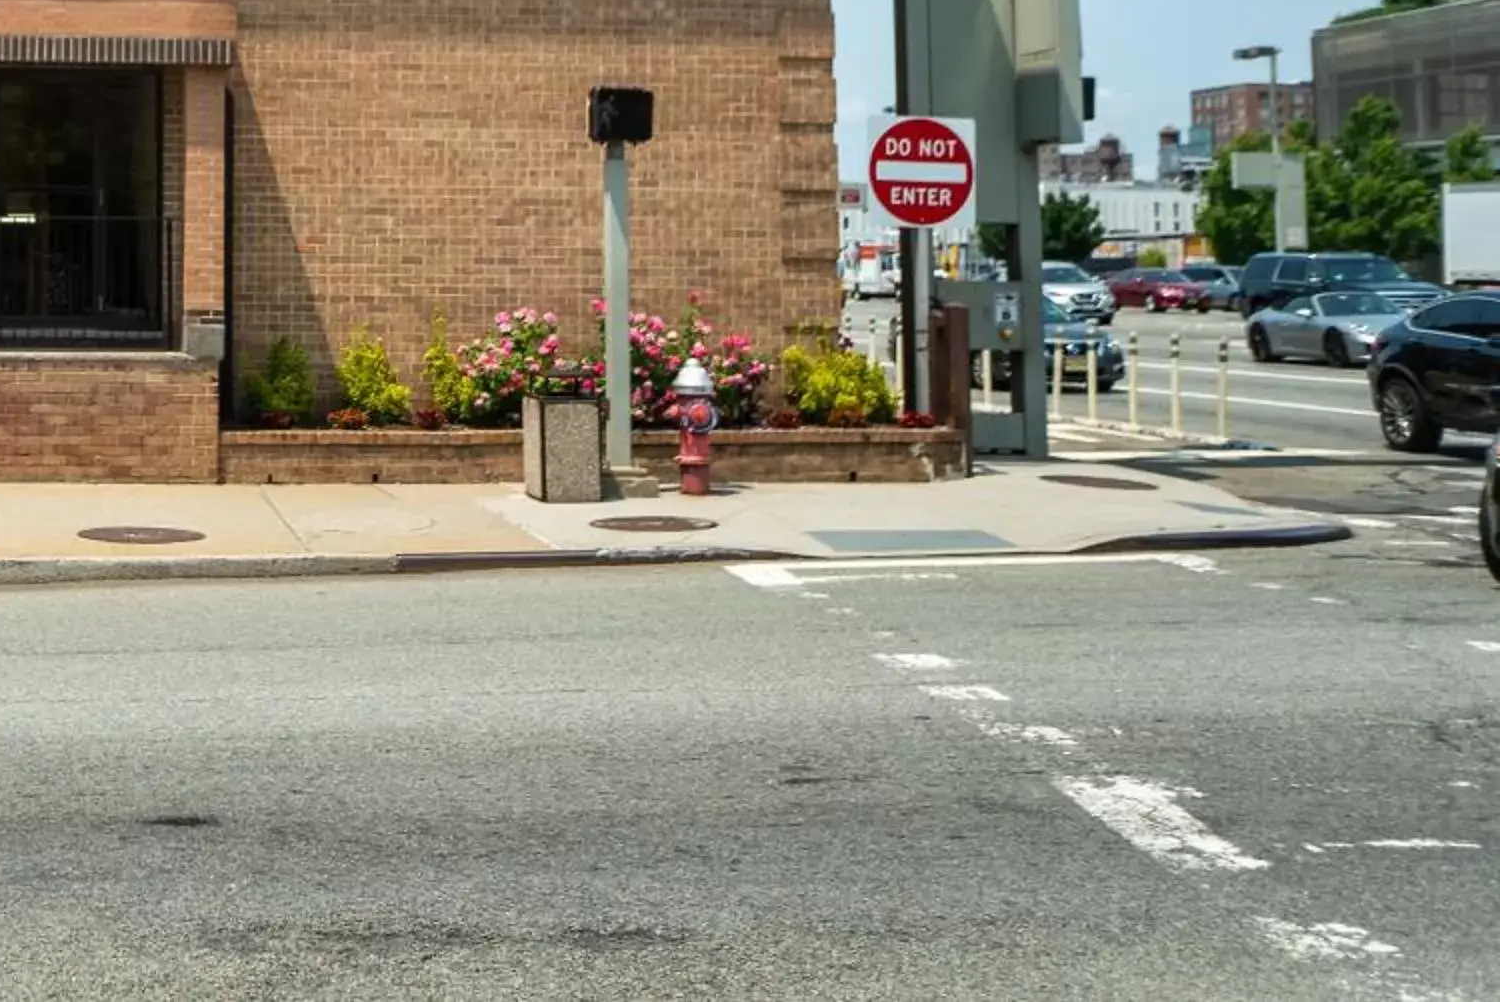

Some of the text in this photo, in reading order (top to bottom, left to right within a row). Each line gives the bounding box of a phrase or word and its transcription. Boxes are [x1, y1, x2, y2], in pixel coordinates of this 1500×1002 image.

[885, 138, 957, 158] DO NOT
[890, 185, 952, 206] ENTER
